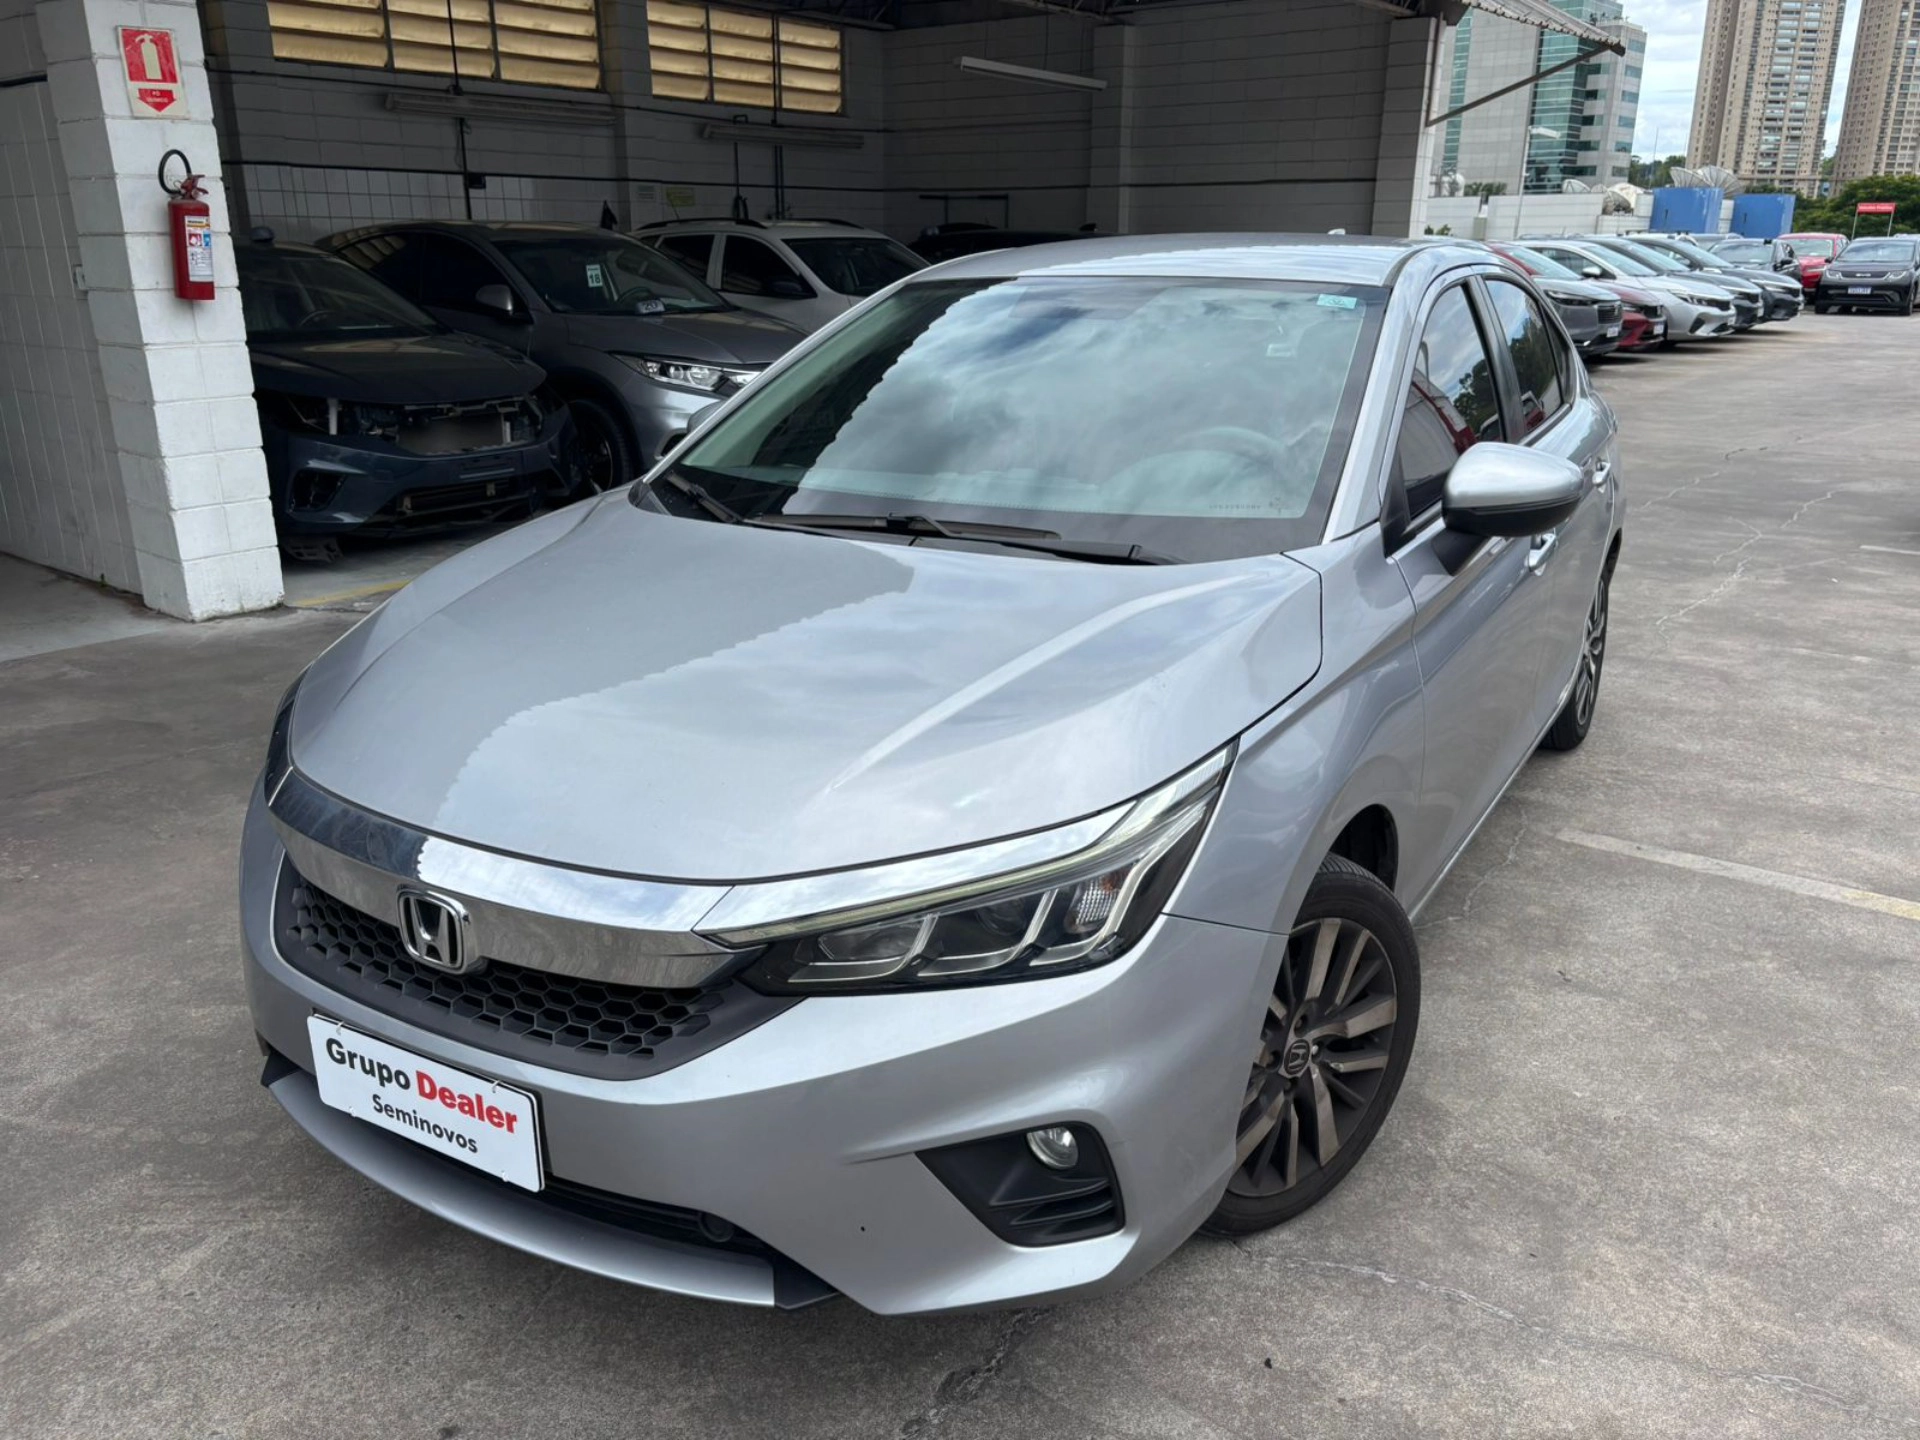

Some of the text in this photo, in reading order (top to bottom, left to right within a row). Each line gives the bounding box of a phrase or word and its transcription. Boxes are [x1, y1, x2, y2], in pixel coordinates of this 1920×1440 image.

[589, 273, 601, 284] 18
[326, 1037, 517, 1134] Grupo Dealer
[372, 1094, 478, 1153] Seminovos
